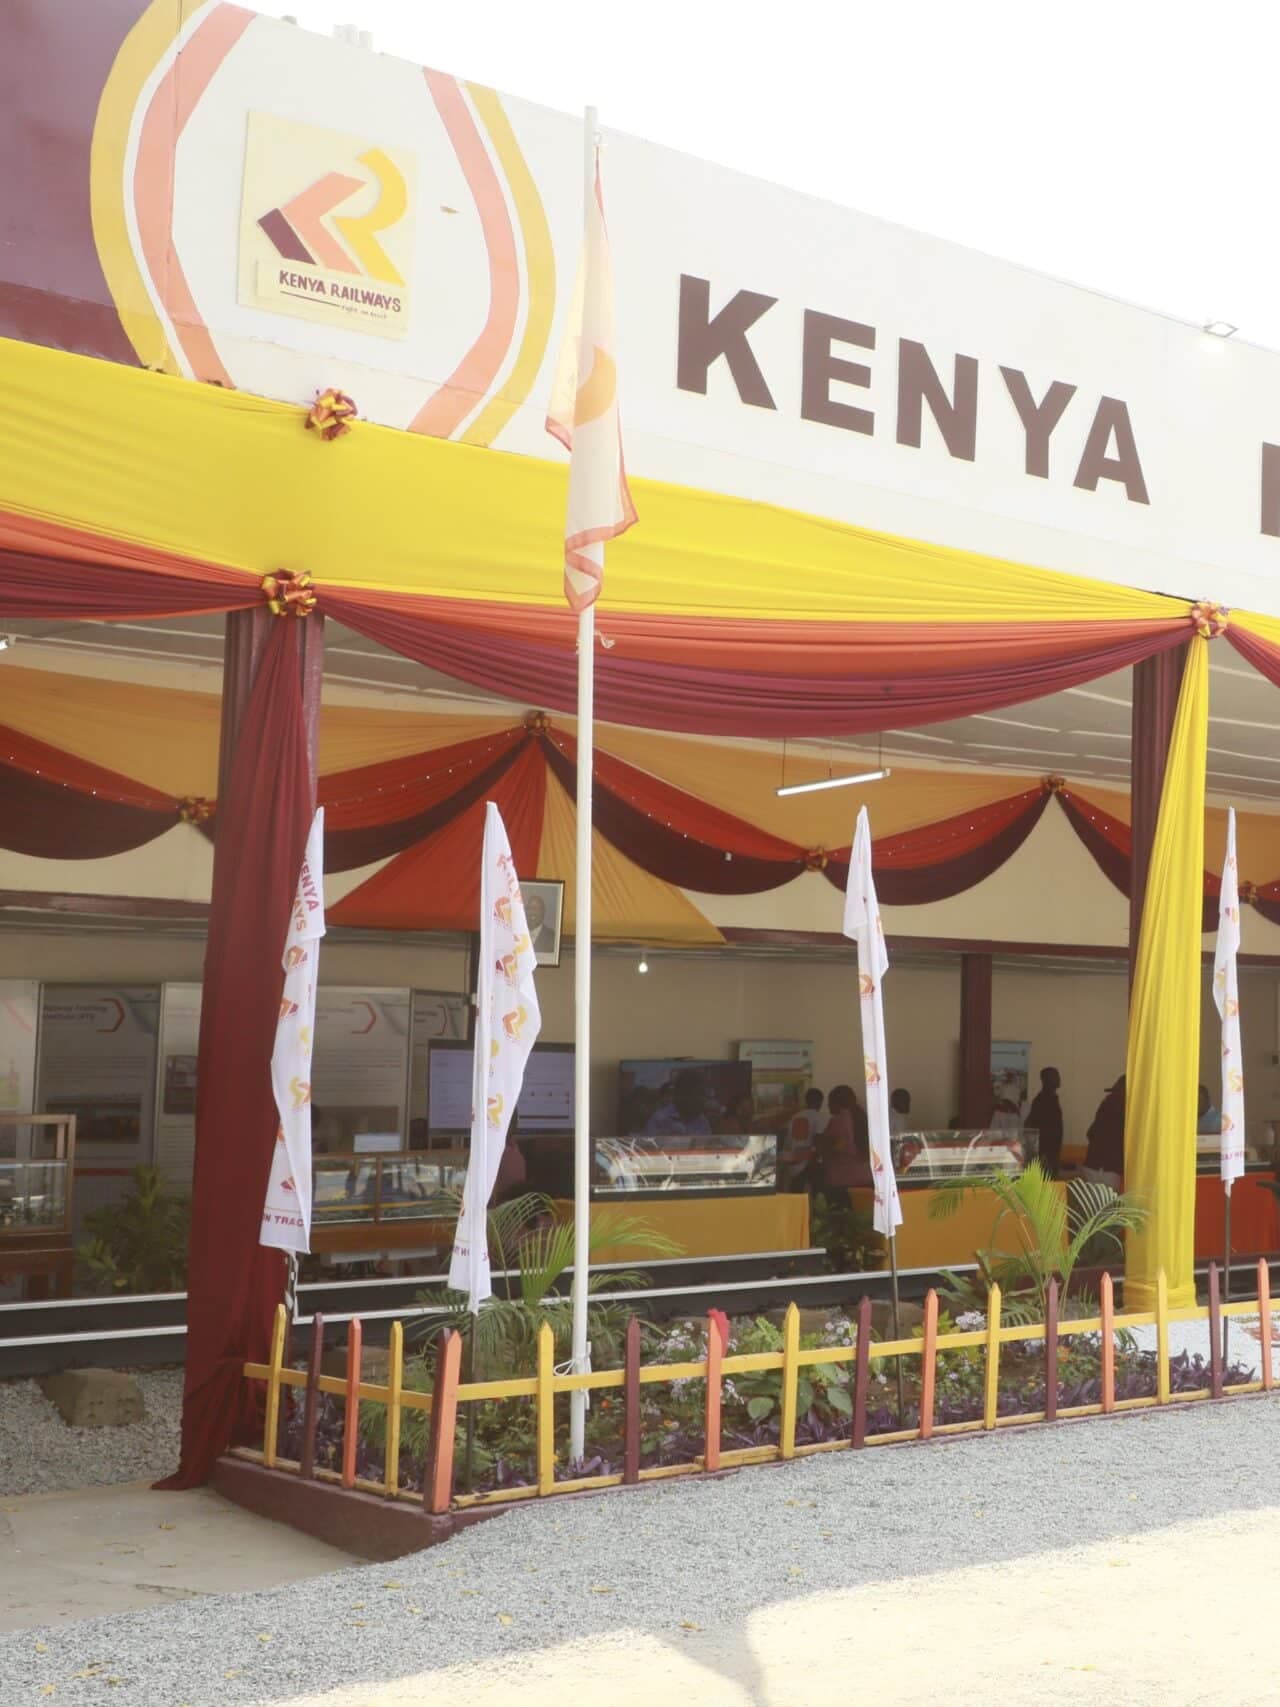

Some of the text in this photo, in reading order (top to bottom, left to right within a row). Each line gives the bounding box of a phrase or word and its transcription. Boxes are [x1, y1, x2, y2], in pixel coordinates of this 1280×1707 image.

[279, 270, 326, 295] KENYA
[330, 283, 401, 313] RAILWAYS
[676, 273, 1150, 505] KENYA
